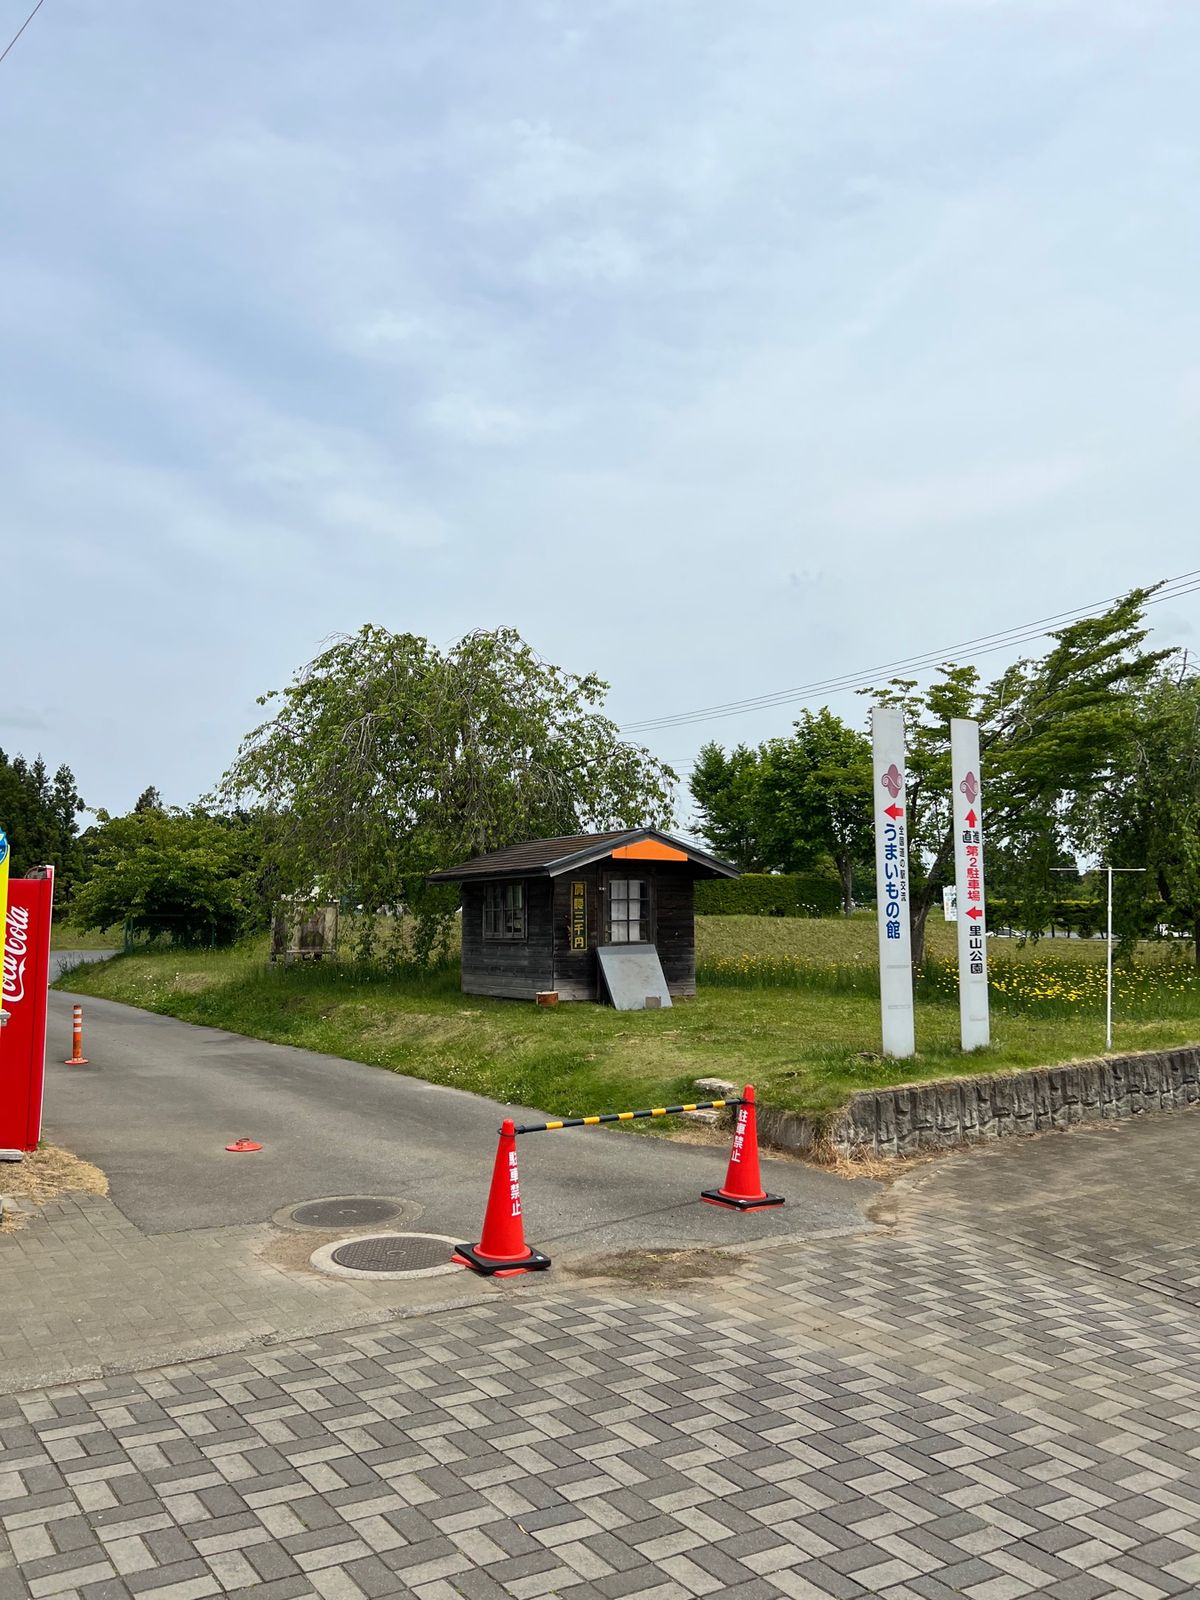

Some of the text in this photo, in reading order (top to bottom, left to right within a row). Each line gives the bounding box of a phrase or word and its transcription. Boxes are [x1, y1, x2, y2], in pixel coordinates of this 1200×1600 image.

[884, 823, 901, 939] うまいもの館
[965, 845, 981, 902] 第2駐車場
[2, 905, 29, 1002] CocaCola
[969, 925, 984, 974] 里山公園
